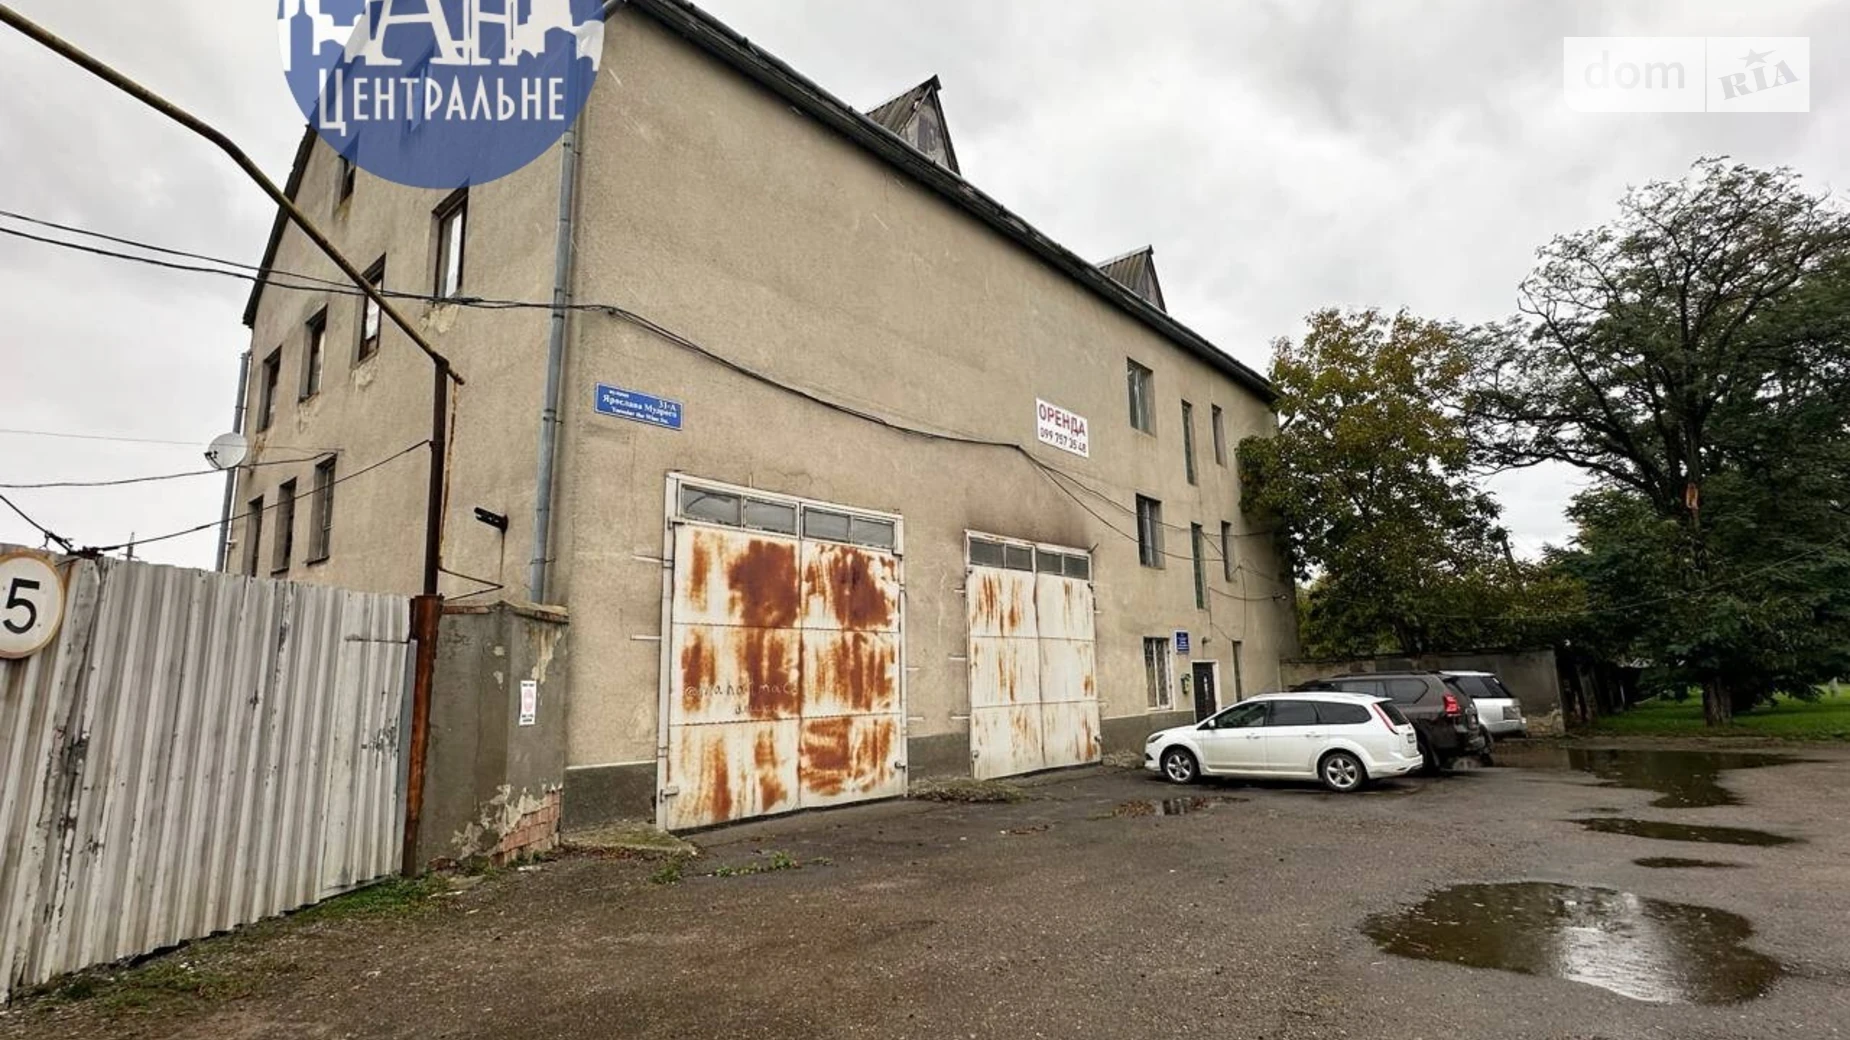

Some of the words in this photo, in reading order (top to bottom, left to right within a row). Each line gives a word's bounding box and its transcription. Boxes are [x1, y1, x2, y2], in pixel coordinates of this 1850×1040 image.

[602, 394, 643, 410] Ярослава
[644, 403, 677, 418] Мудрого
[1039, 403, 1086, 437] ОРЕНДА
[1040, 427, 1053, 440] 099
[3, 577, 40, 635] 5
